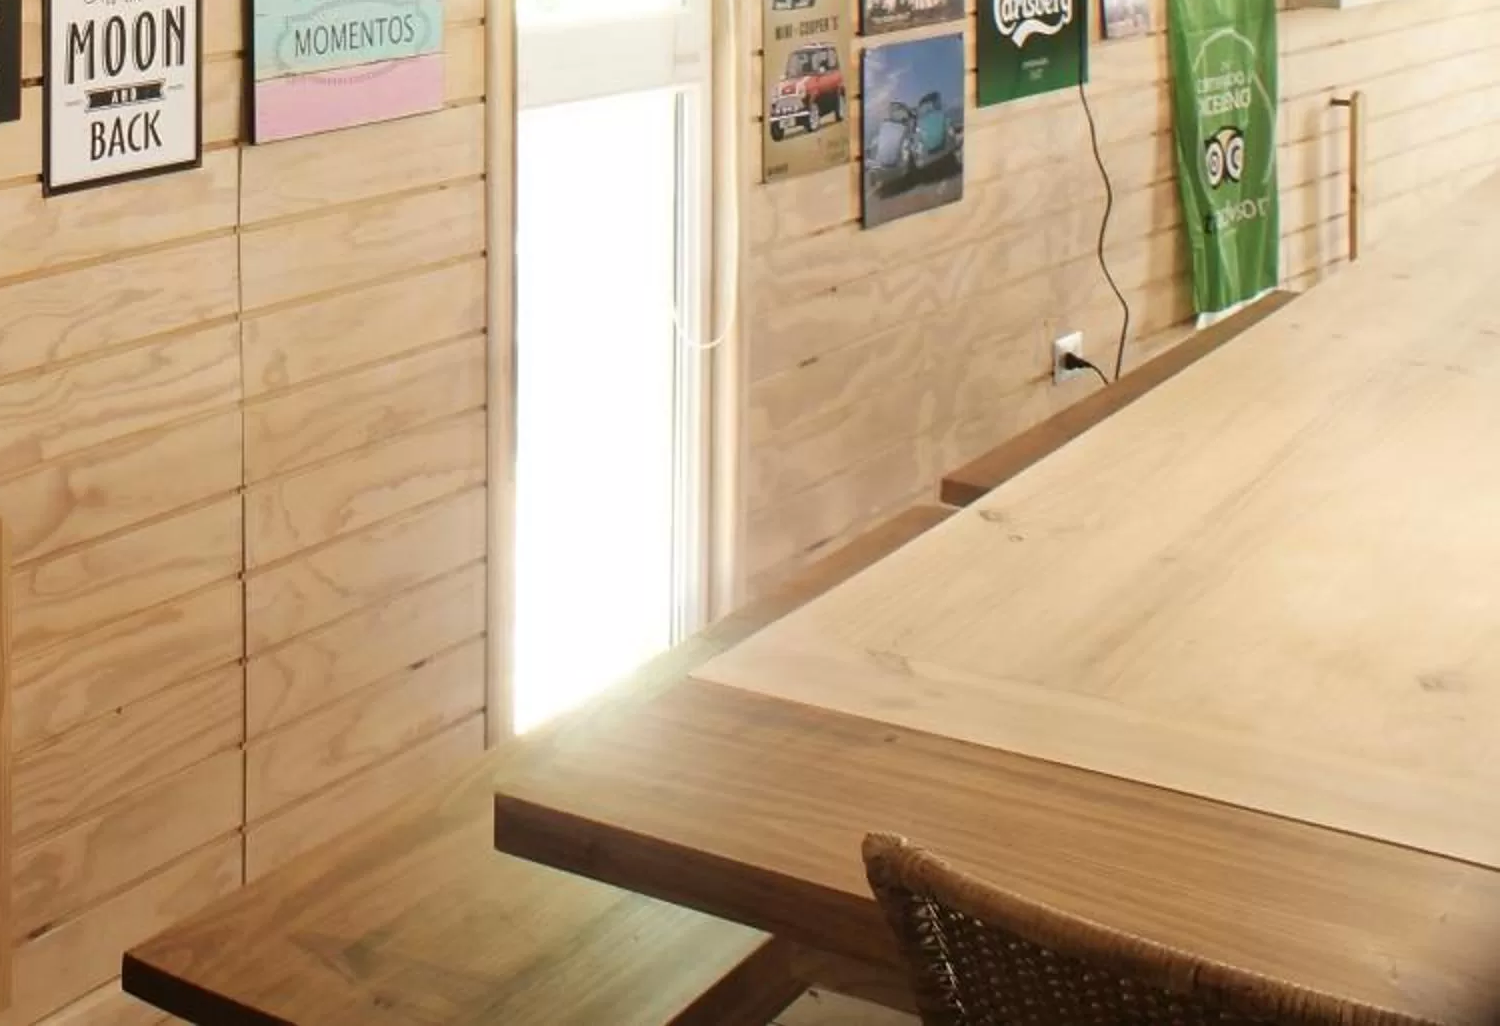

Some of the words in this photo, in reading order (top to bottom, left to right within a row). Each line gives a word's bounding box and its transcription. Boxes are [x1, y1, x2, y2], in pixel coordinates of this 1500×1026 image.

[64, 5, 186, 85] MOON
[293, 14, 415, 58] MOMENTOS
[90, 109, 163, 161] BACK
